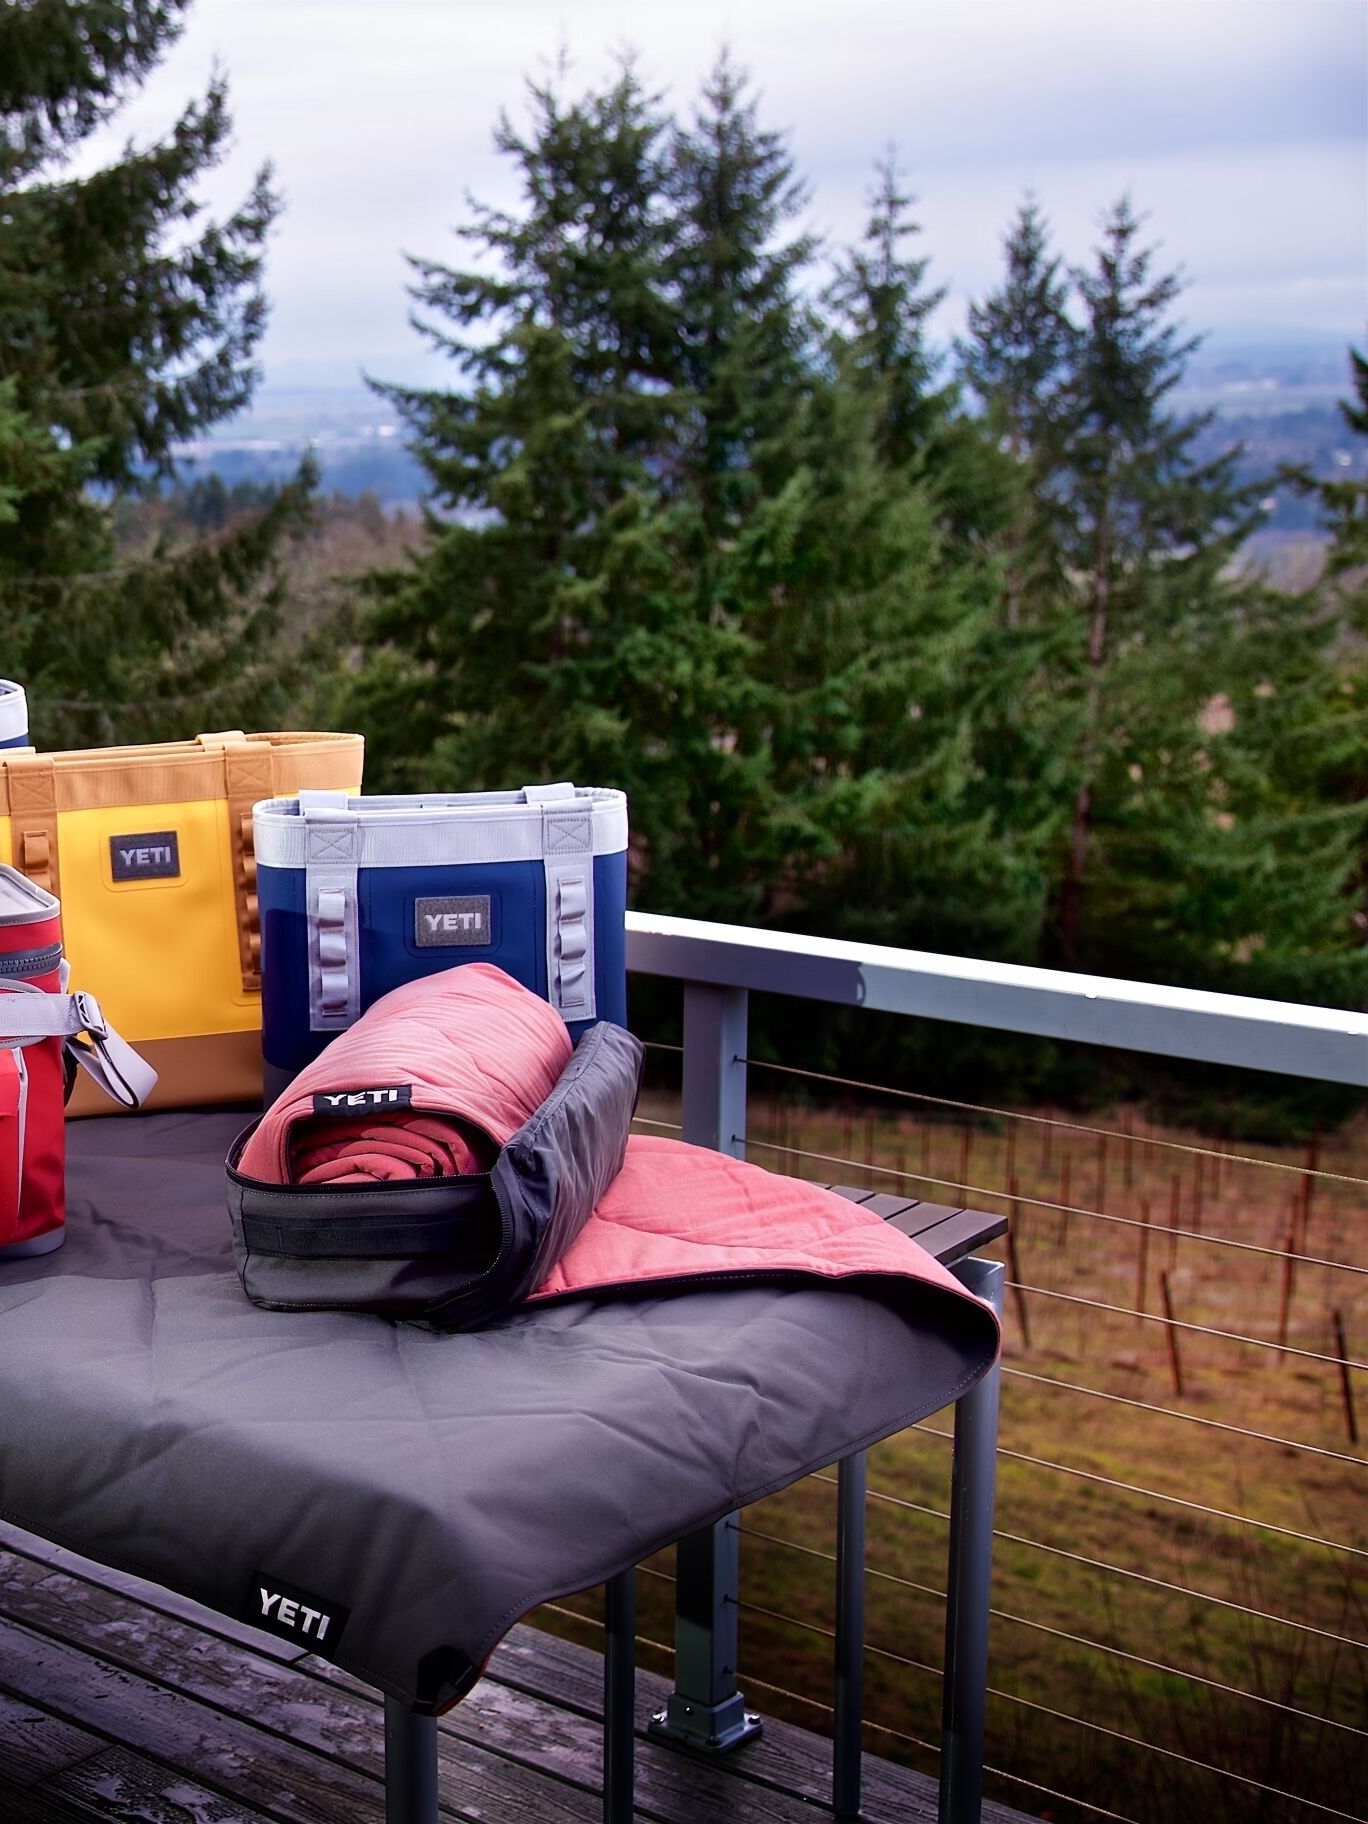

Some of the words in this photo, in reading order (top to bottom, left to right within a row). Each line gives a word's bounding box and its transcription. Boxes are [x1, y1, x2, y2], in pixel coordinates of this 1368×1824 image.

[119, 846, 172, 867] YETI
[424, 912, 482, 931] YETI
[323, 1089, 399, 1106] YETI
[259, 1587, 331, 1641] YETI
